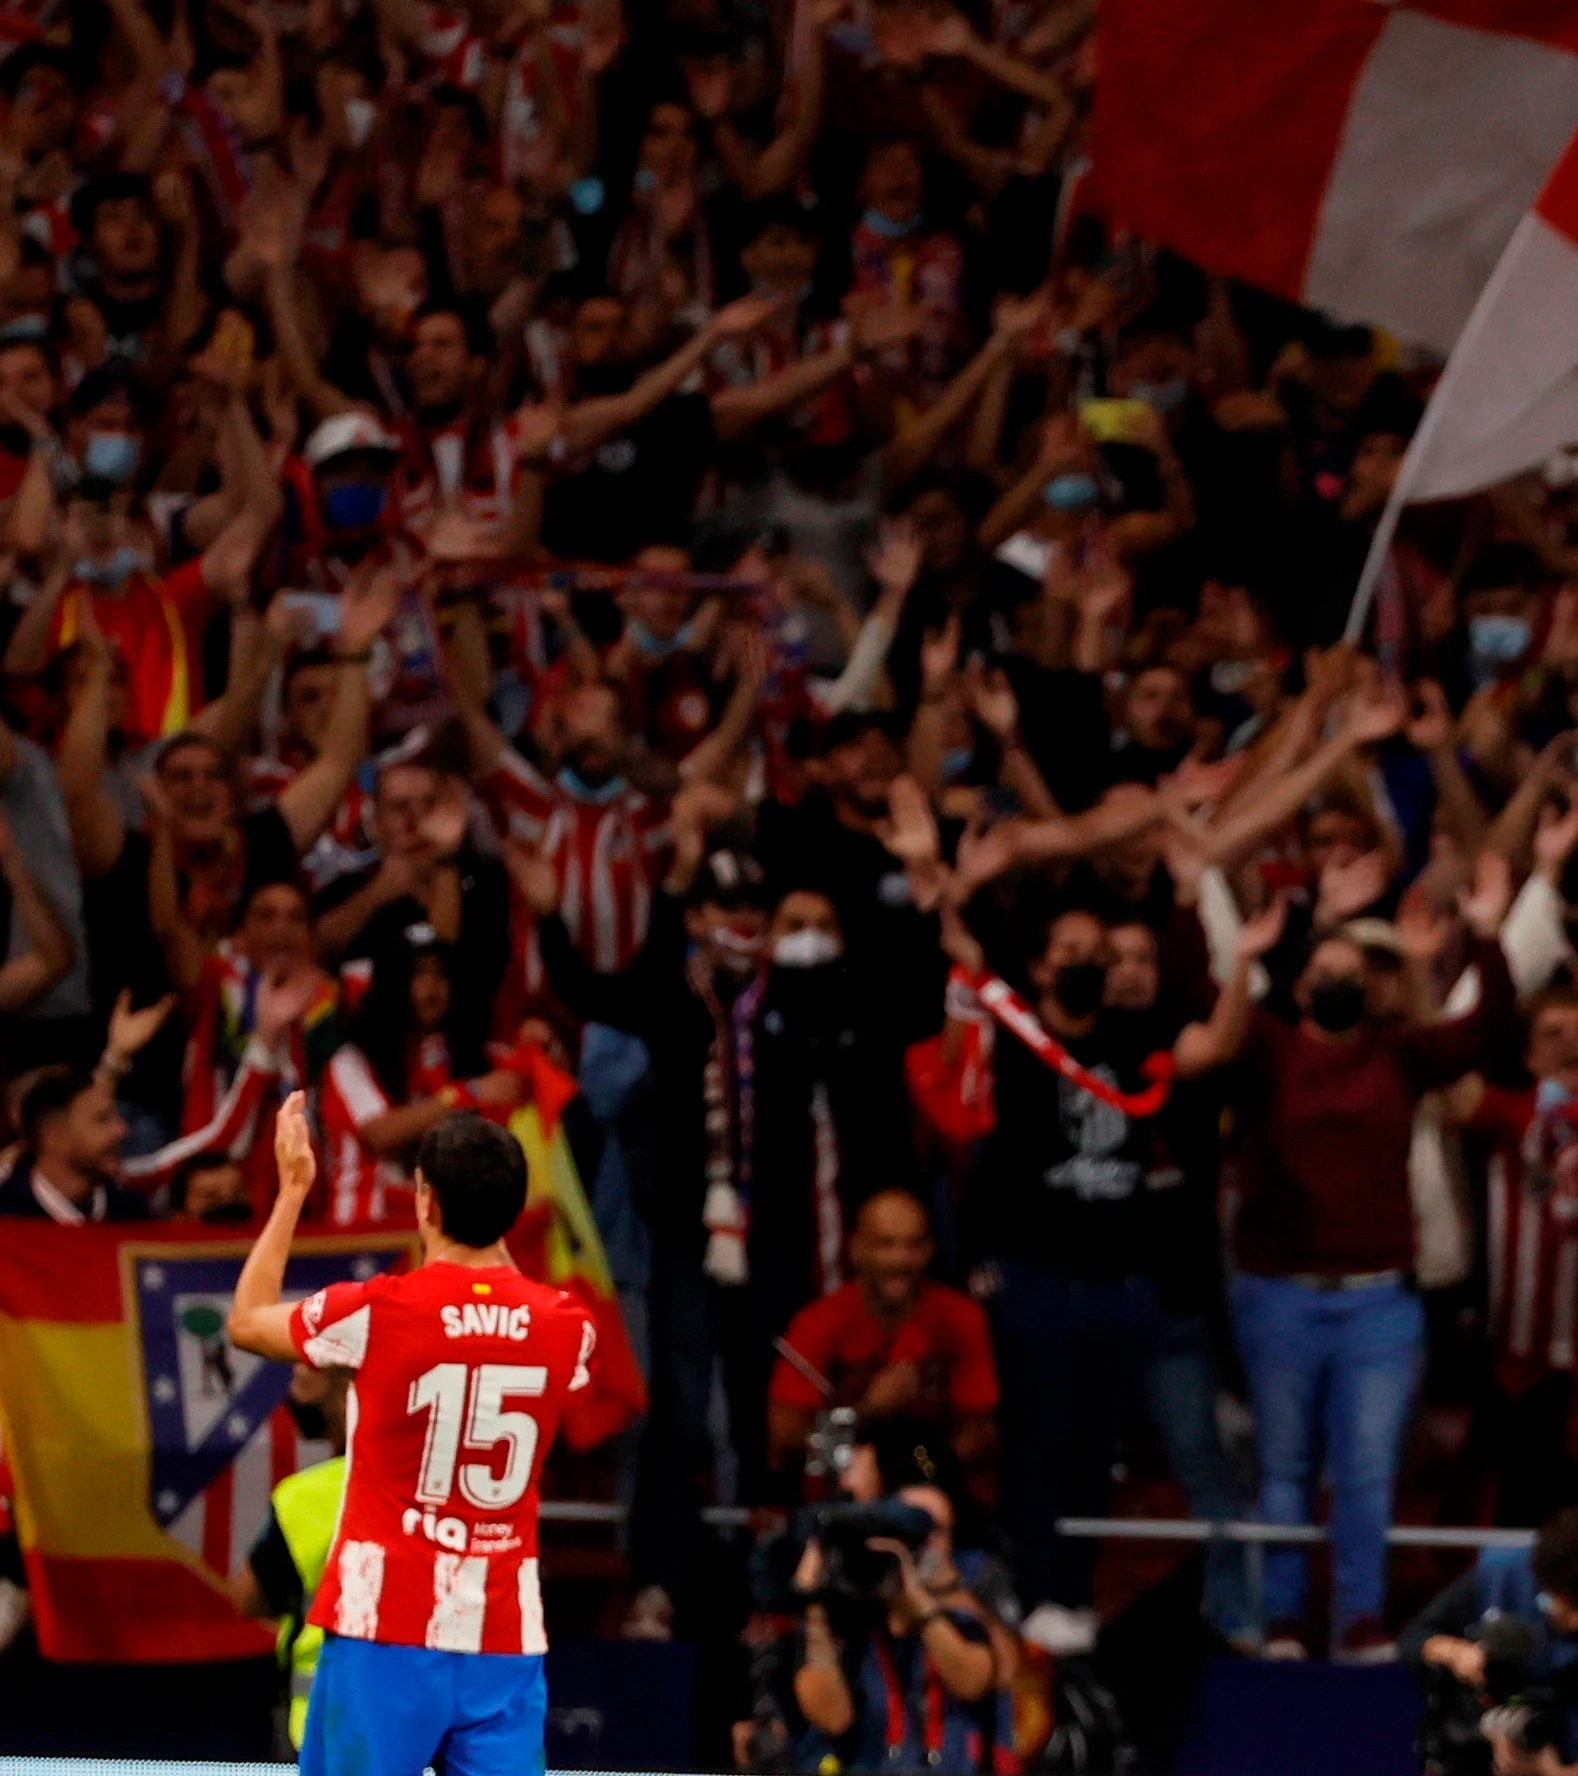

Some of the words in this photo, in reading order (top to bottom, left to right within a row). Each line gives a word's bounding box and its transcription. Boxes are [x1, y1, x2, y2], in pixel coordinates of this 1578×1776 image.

[440, 1302, 531, 1342] SAVIĆ
[406, 1362, 548, 1510] 15
[402, 1502, 468, 1552] ria
